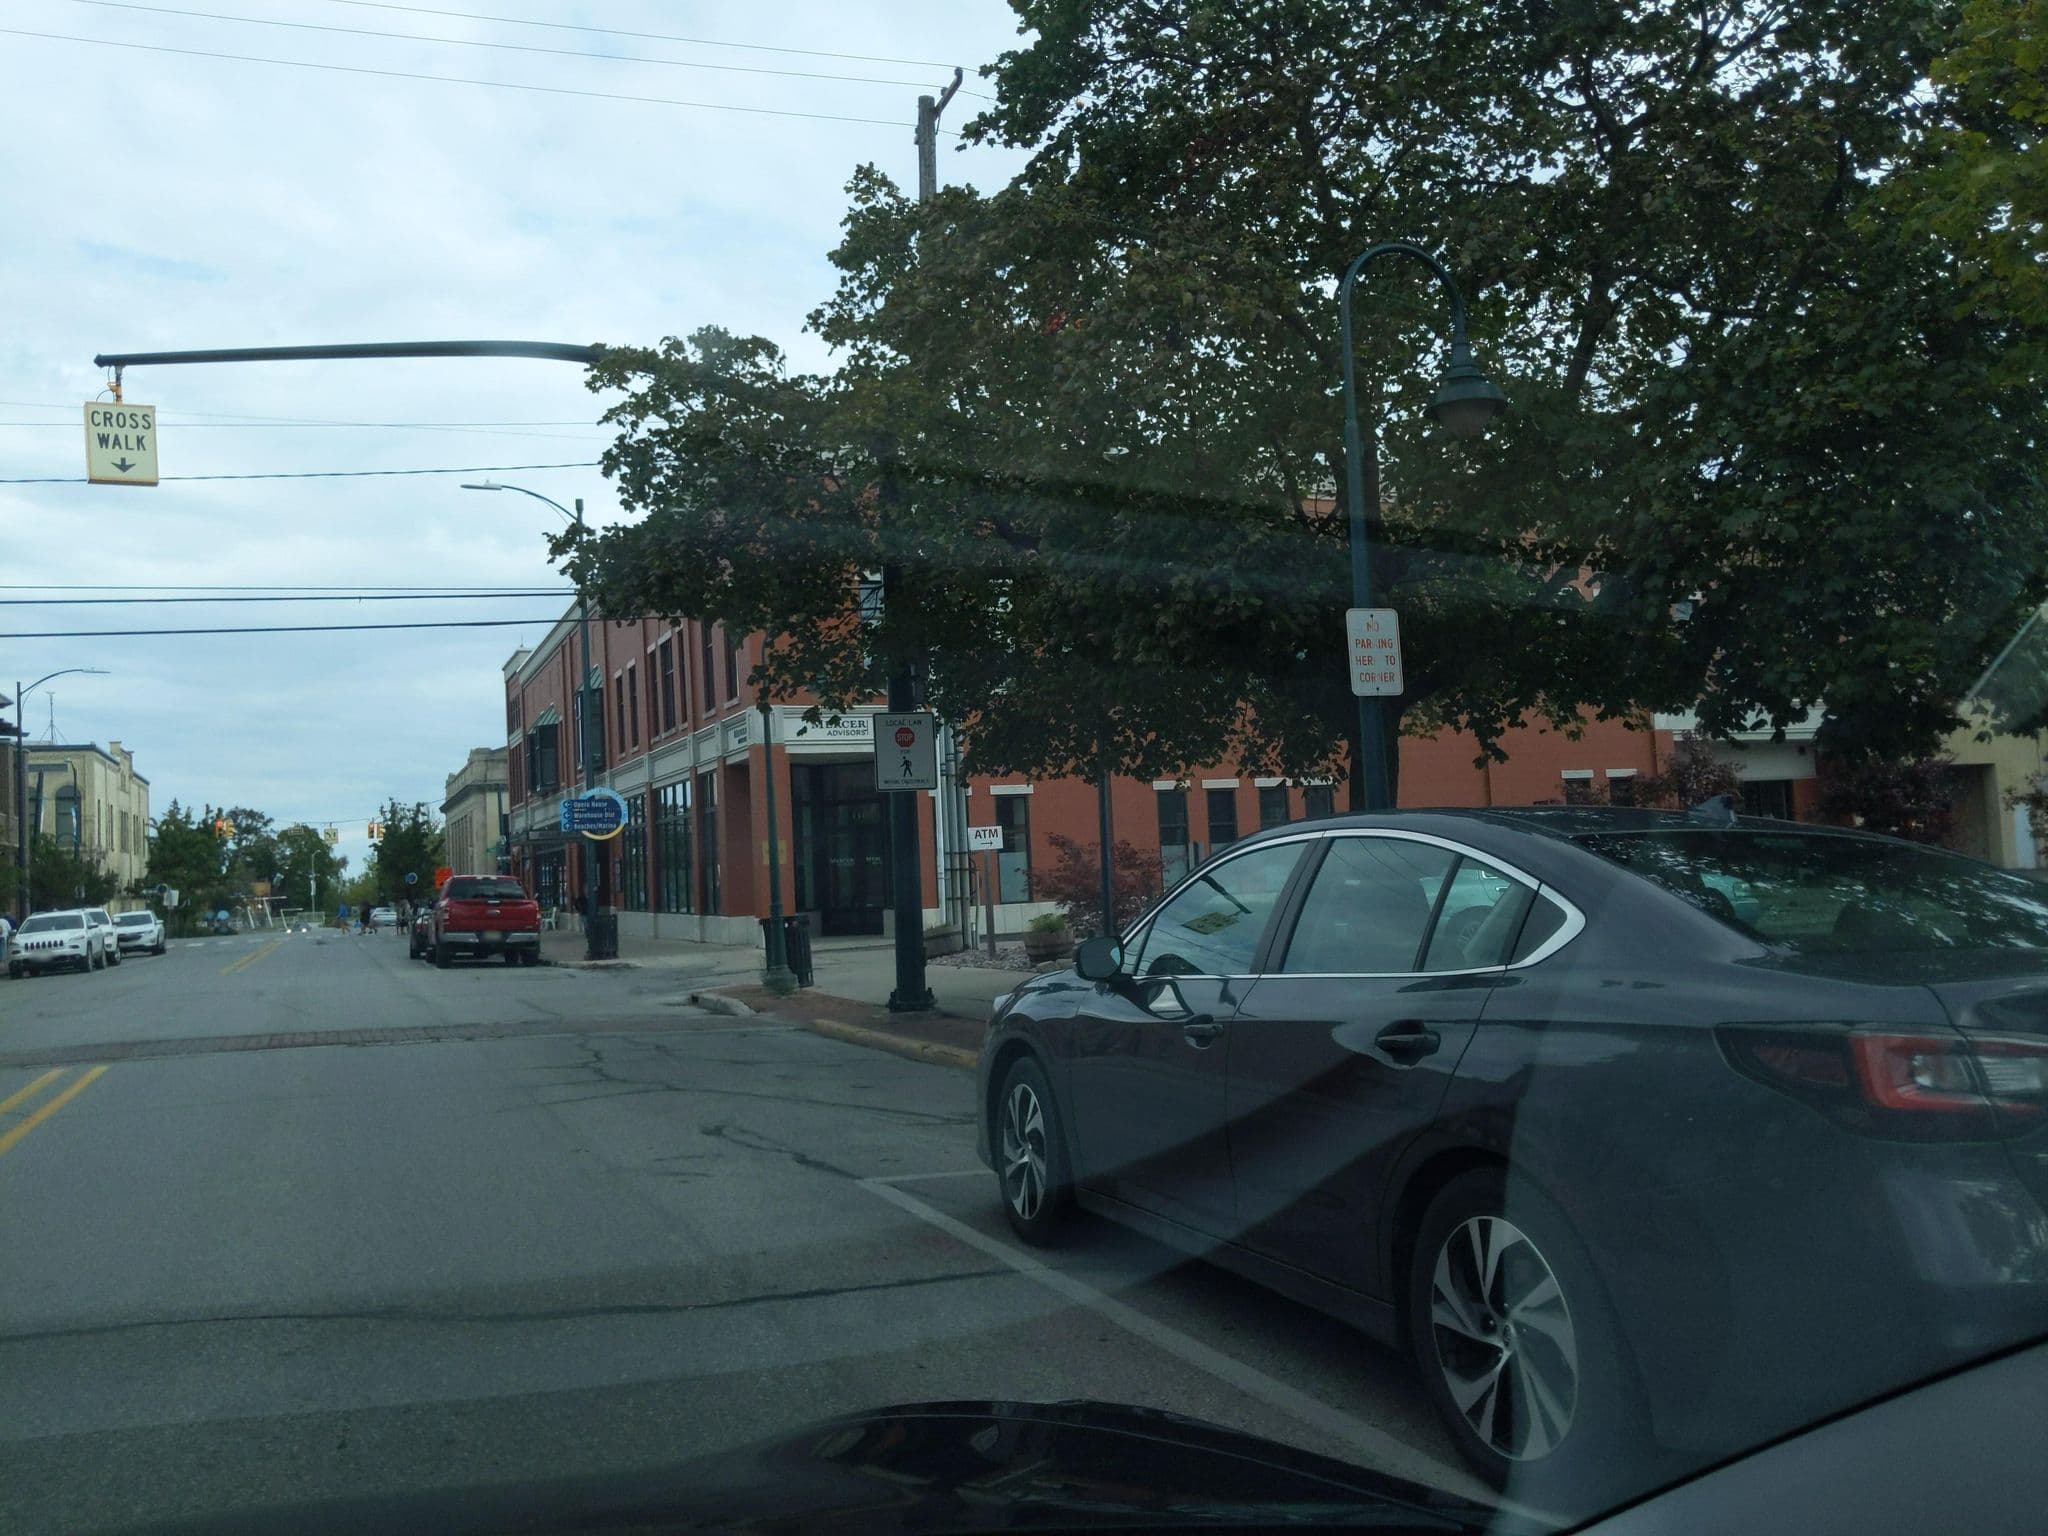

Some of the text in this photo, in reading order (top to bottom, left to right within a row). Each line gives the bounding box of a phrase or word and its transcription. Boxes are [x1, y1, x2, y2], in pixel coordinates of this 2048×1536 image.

[91, 410, 151, 430] CROSS
[97, 432, 146, 451] WALK
[1367, 622, 1379, 632] NO
[1355, 639, 1393, 648] PARING
[1356, 656, 1396, 666] HER TO
[974, 828, 998, 839] ATM
